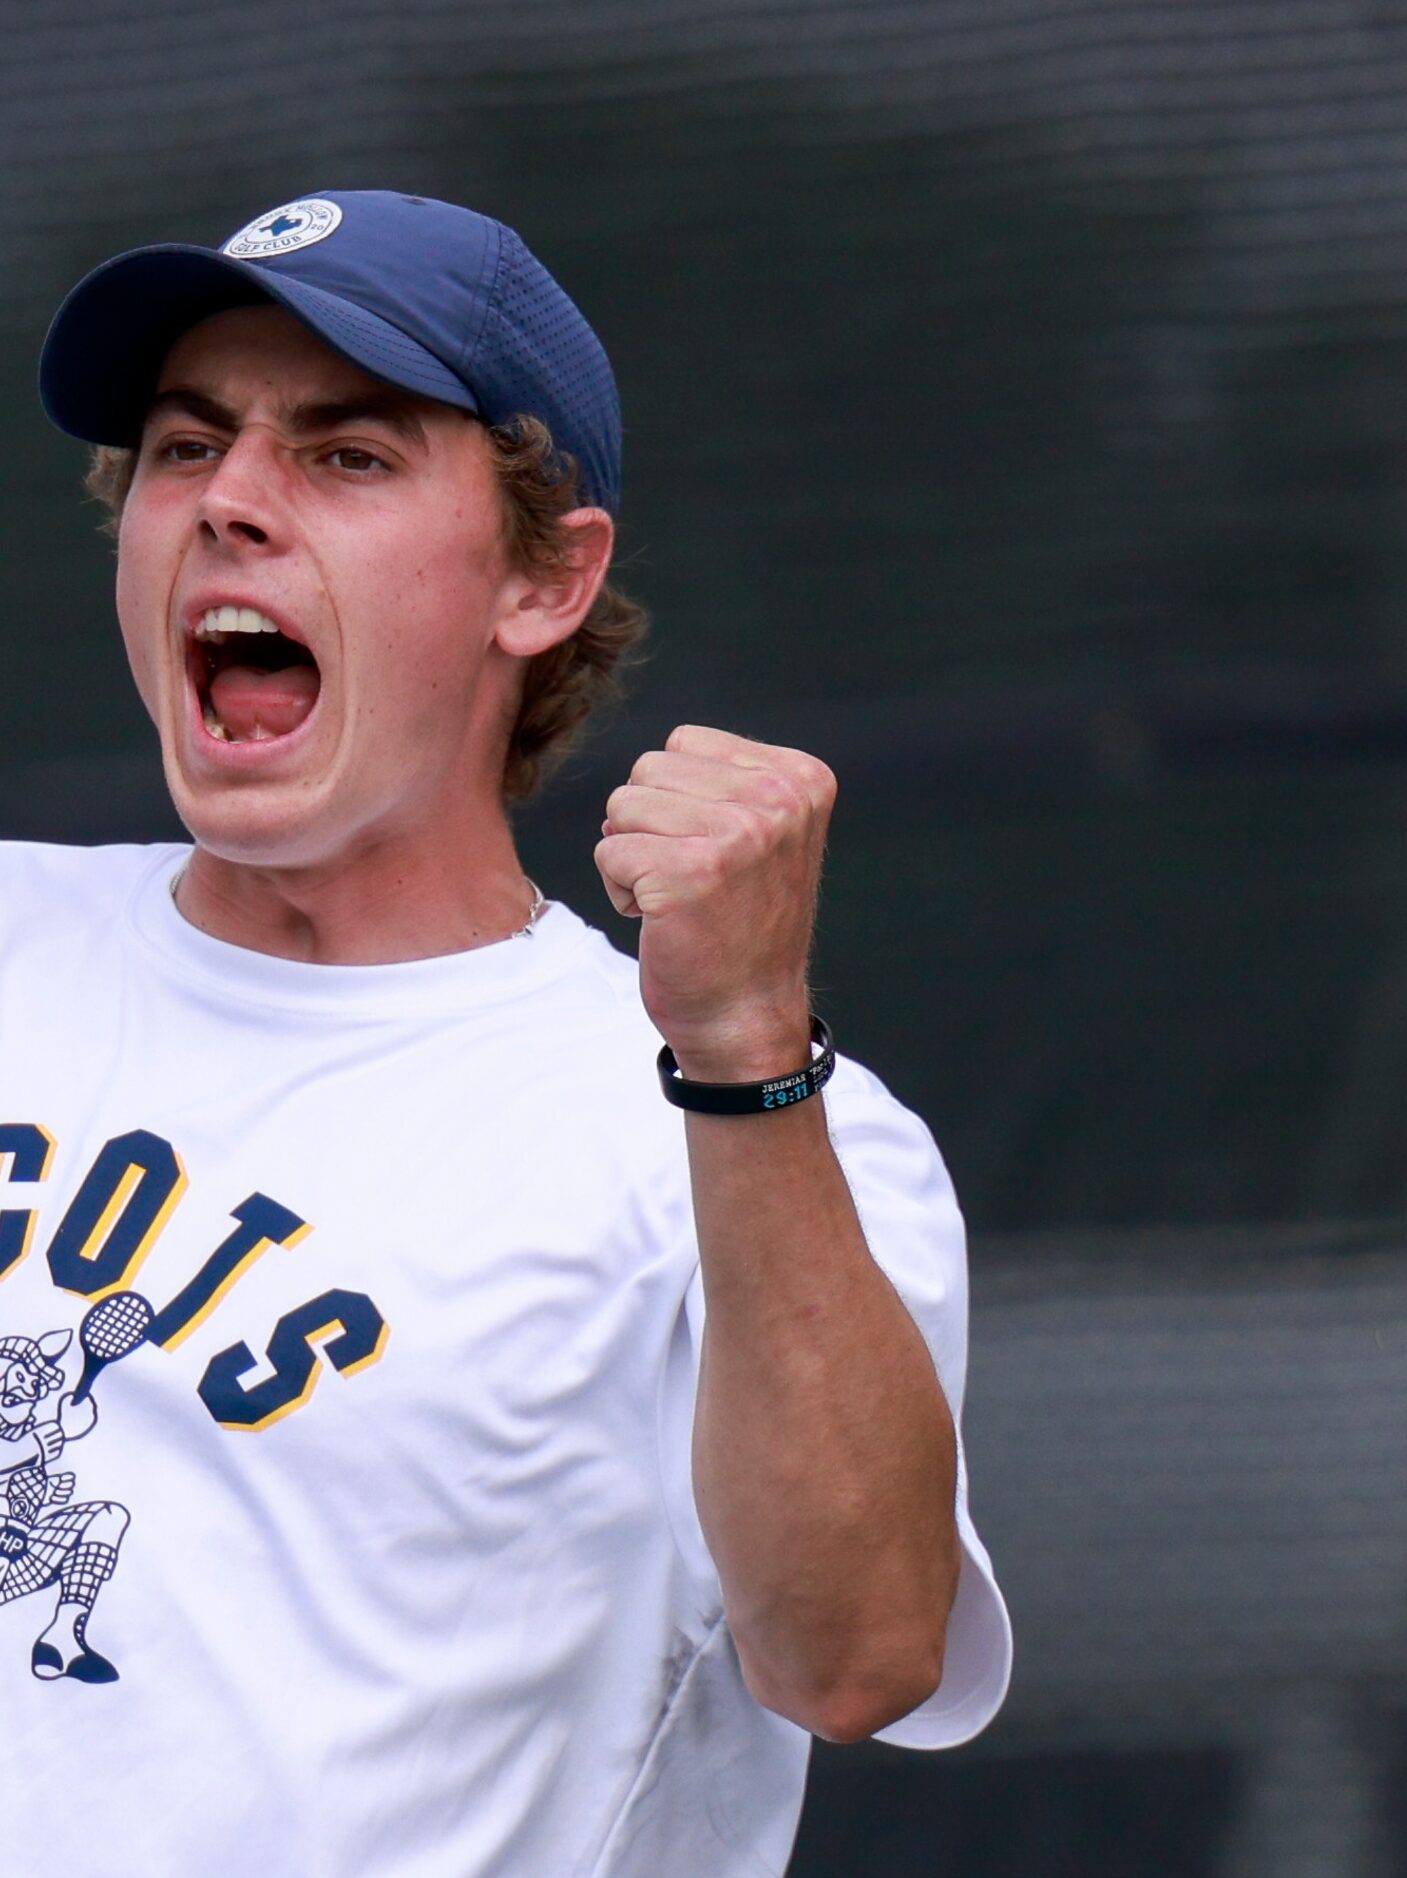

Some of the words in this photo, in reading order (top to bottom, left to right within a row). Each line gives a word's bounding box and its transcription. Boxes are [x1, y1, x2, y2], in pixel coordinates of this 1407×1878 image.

[263, 236, 302, 250] CLUB
[762, 1073, 806, 1093] JEREMIAS
[763, 1083, 809, 1109] 29:11
